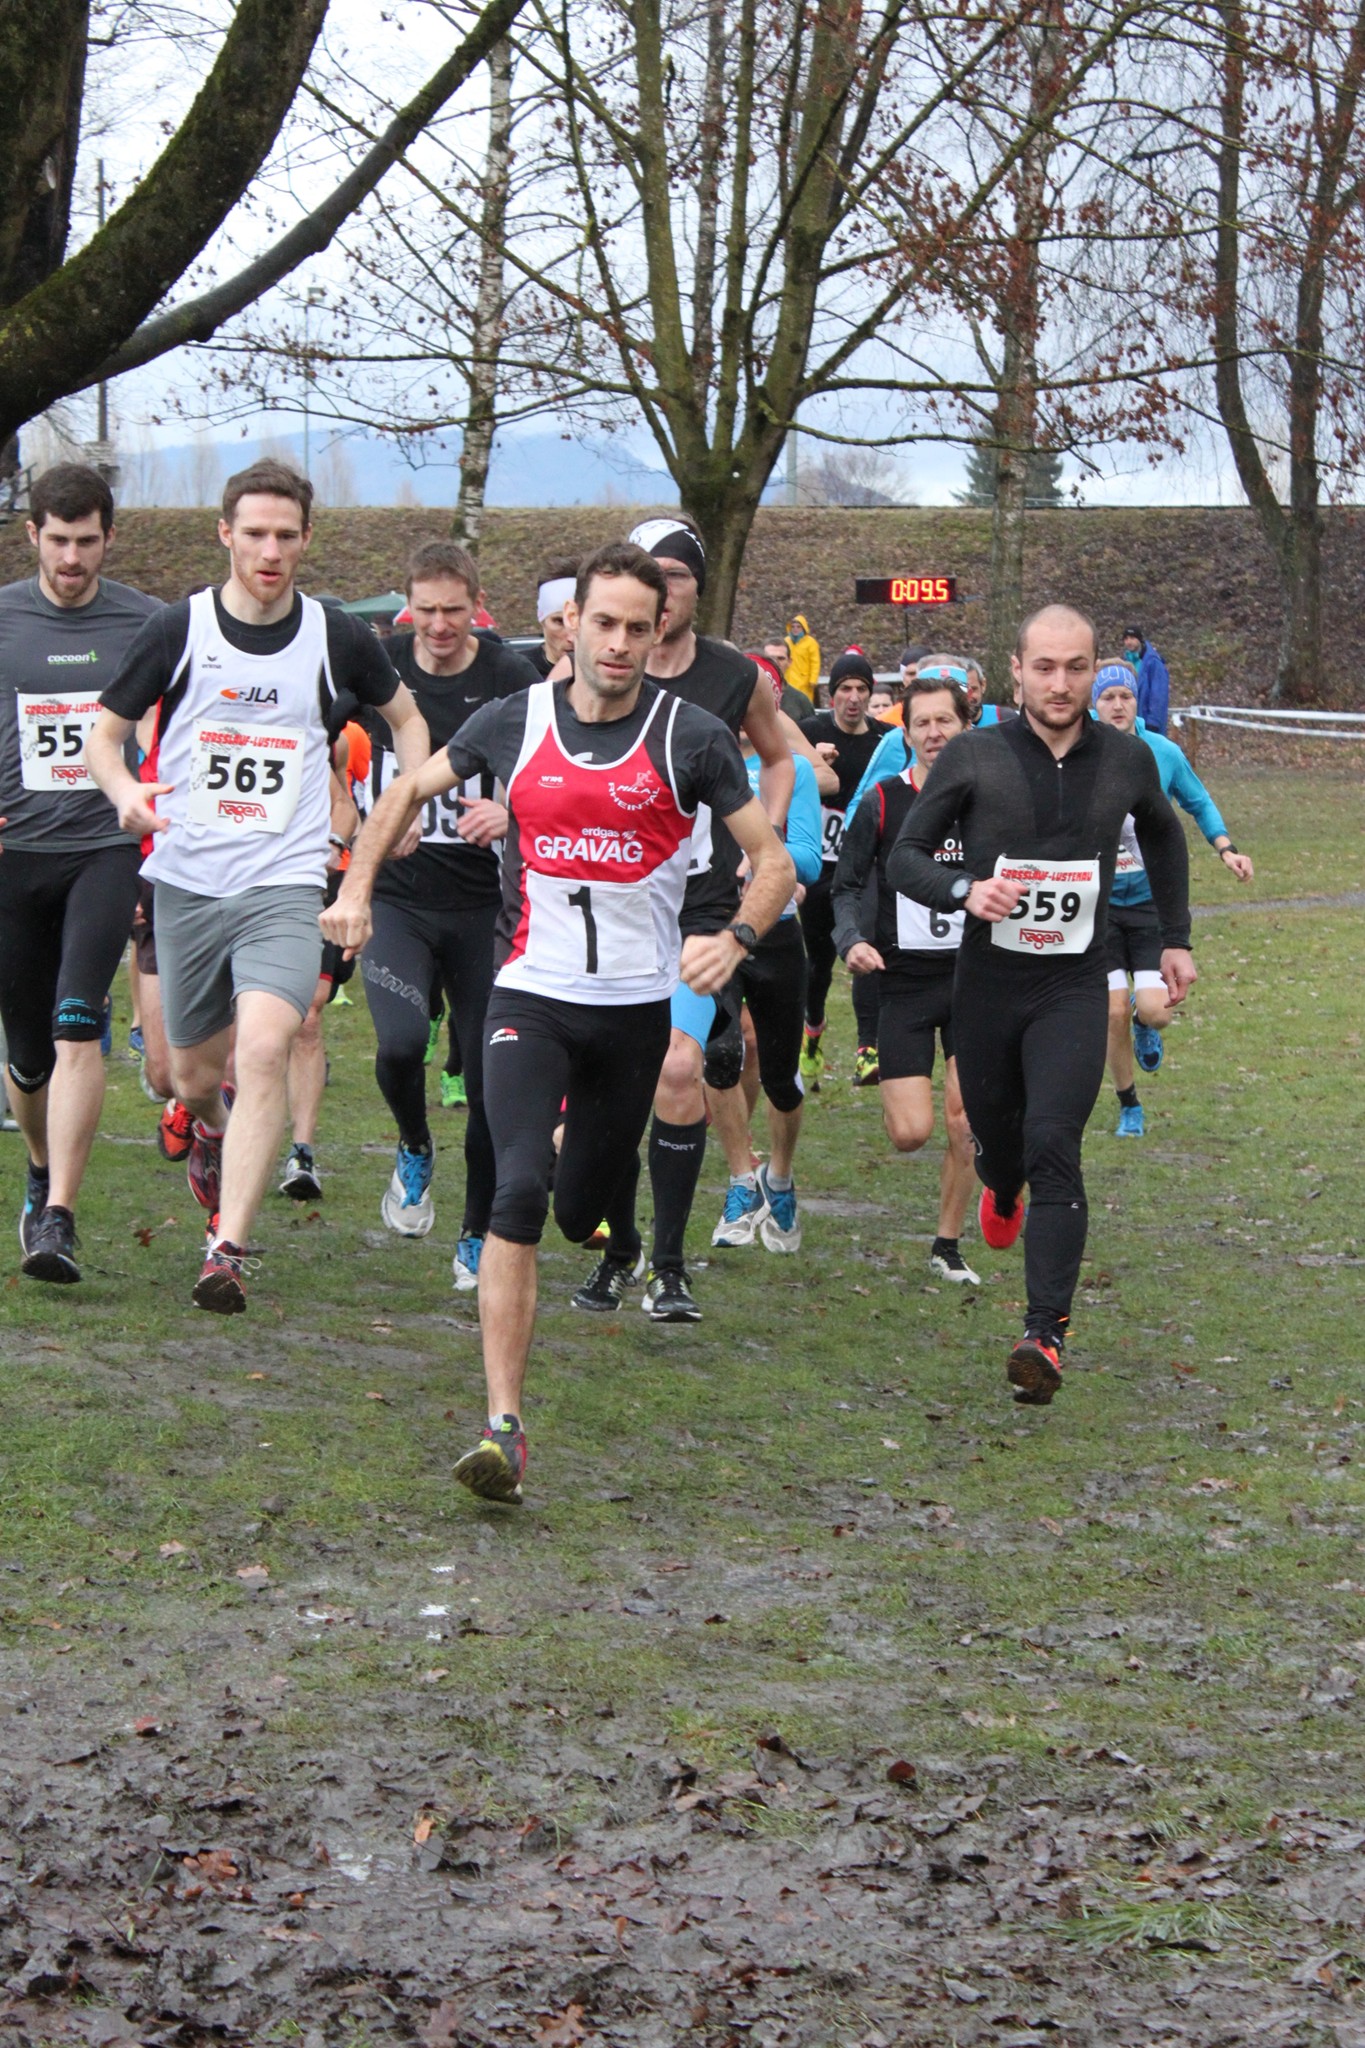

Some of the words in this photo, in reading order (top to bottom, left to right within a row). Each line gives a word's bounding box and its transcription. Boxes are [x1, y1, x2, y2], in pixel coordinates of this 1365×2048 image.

[47, 654, 90, 663] cocoon
[244, 686, 279, 704] JLA
[37, 724, 95, 758] 55
[207, 754, 286, 795] 563
[218, 800, 267, 823] hagen
[582, 827, 620, 838] erdgas
[534, 835, 644, 863] GRAVAG
[1008, 890, 1081, 922] 559
[568, 885, 599, 975] 1
[1019, 928, 1065, 950] hagen
[657, 1138, 697, 1151] SPORT
